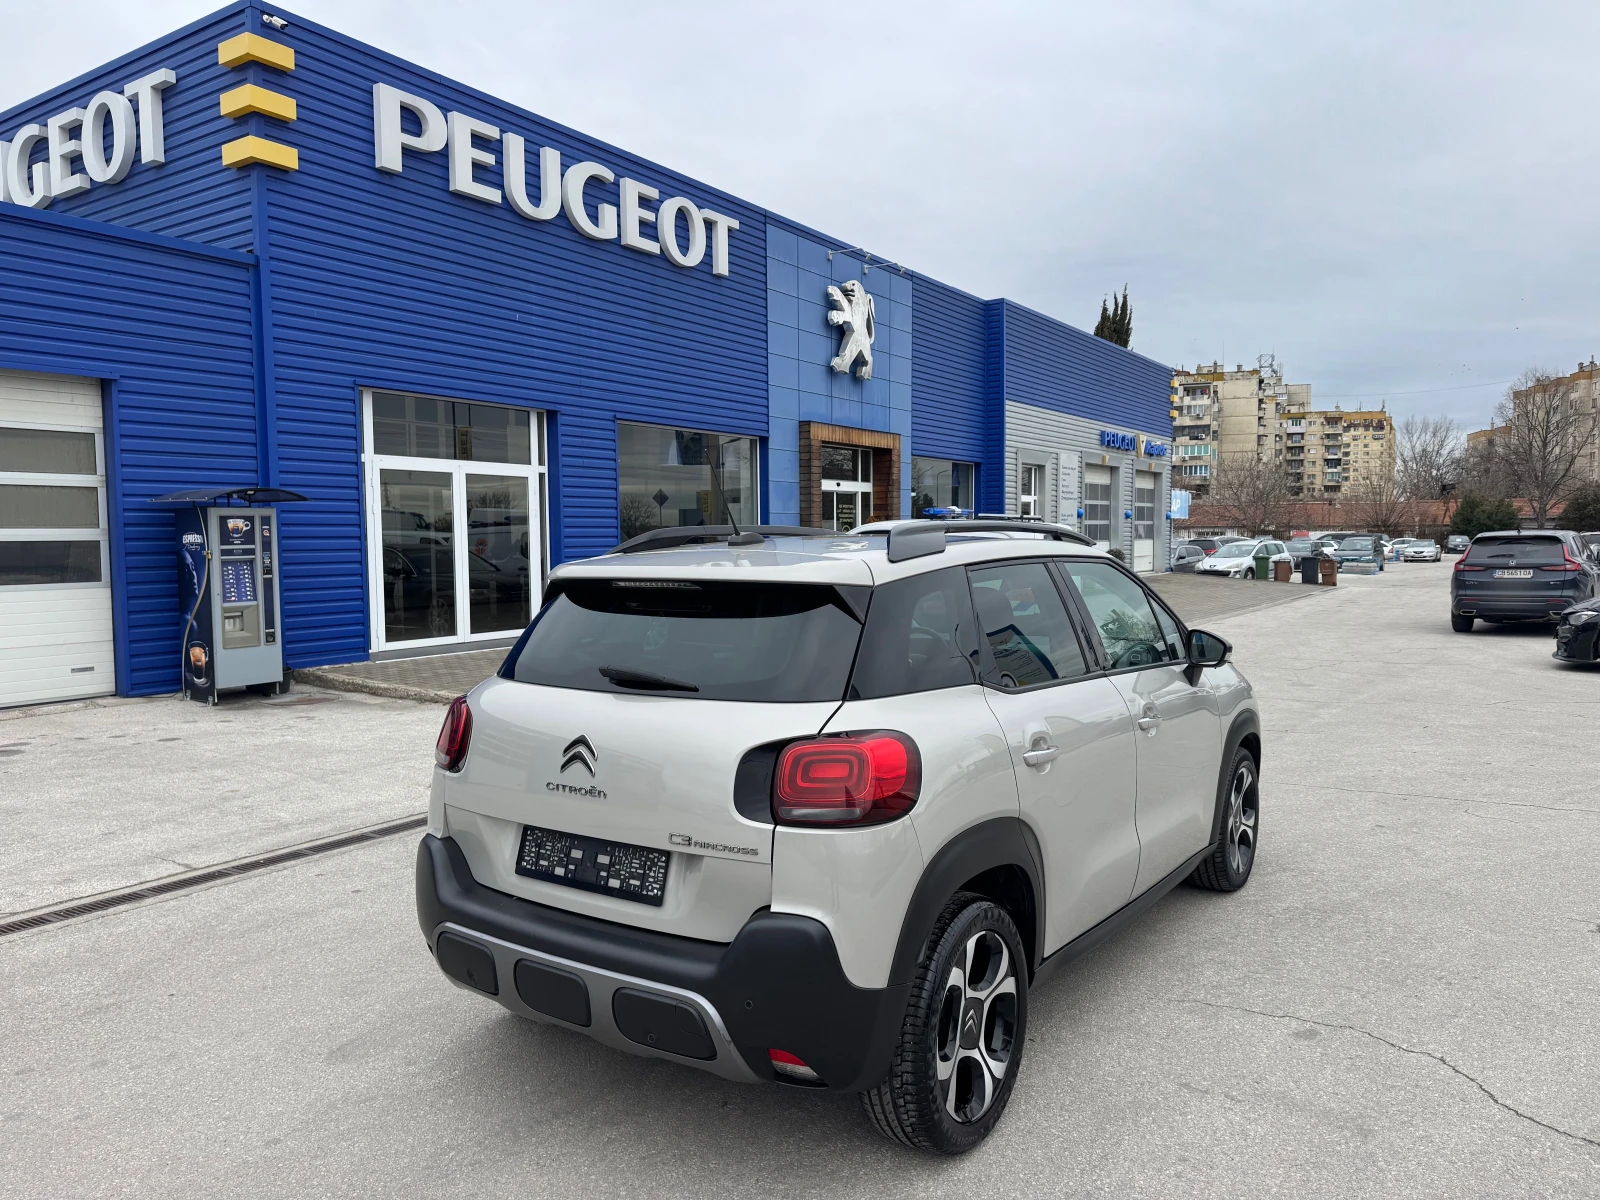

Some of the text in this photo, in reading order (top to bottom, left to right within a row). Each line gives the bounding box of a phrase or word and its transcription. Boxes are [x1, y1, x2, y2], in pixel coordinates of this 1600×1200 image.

[0, 68, 177, 209] GEOT
[373, 82, 740, 276] PEUGEOT
[1101, 431, 1137, 451] PEUGEOT
[668, 832, 759, 856] C3 AIRCROSS
